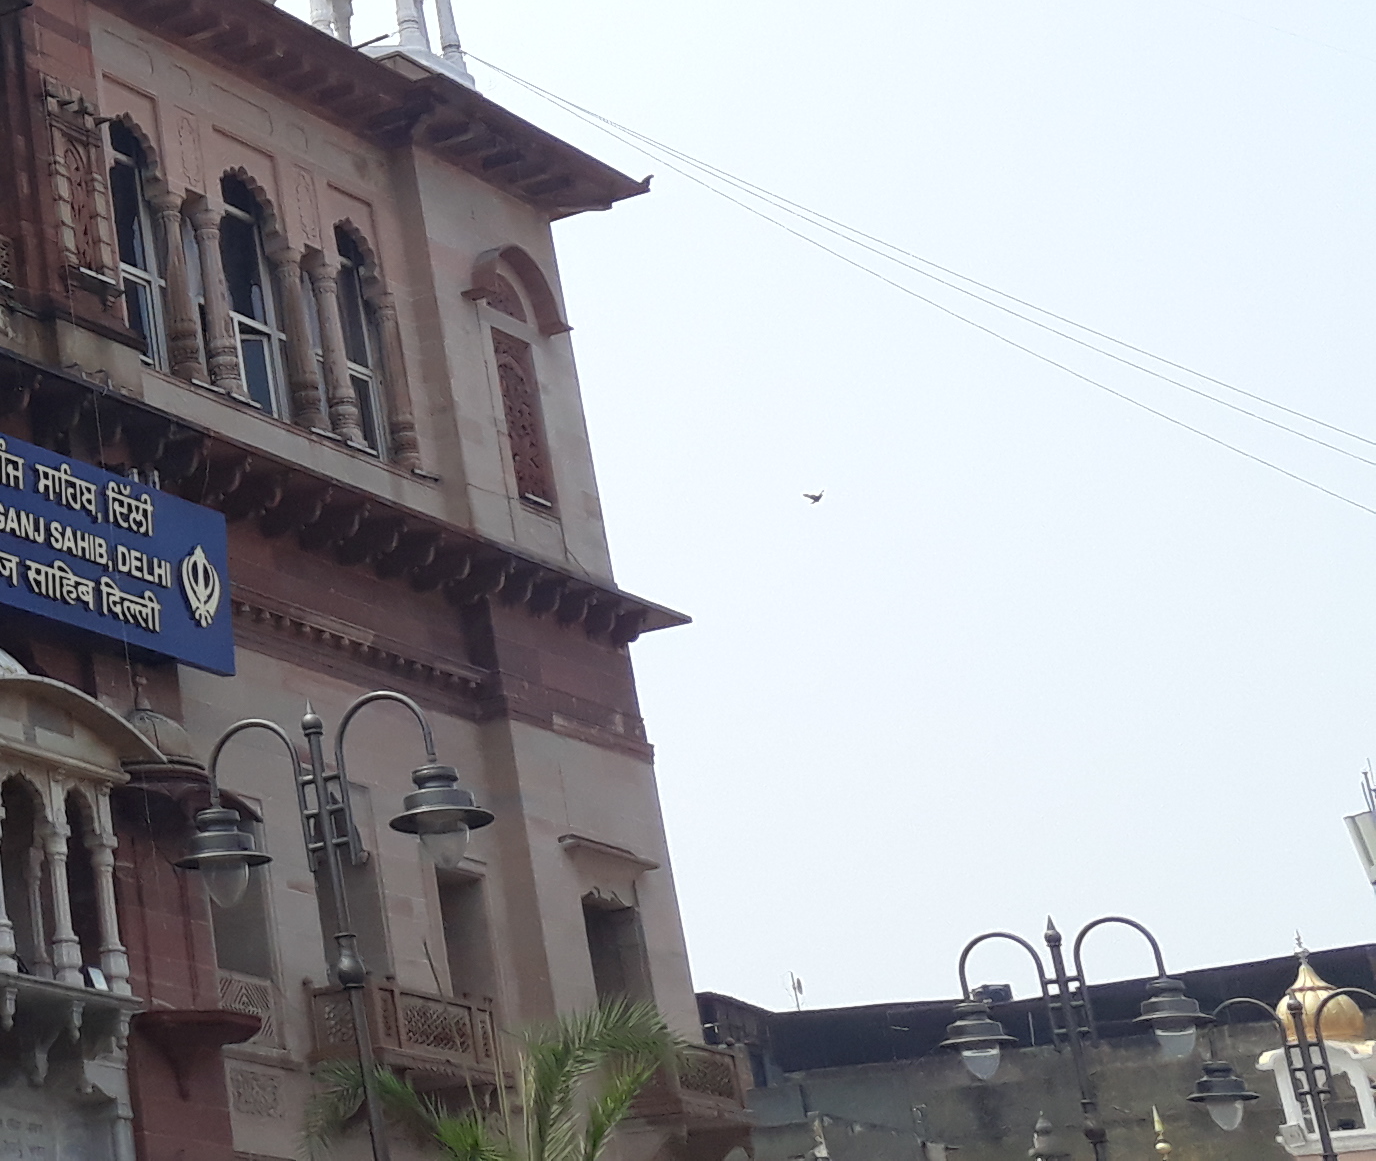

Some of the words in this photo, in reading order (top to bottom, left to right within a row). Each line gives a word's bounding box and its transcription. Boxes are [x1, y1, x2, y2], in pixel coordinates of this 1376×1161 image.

[105, 481, 154, 537] ਦਿੱਲੀ
[50, 521, 113, 572] SAHIB,
[117, 544, 172, 588] DELHI
[25, 559, 96, 611] साहिब
[99, 576, 162, 633] दिल्ली
